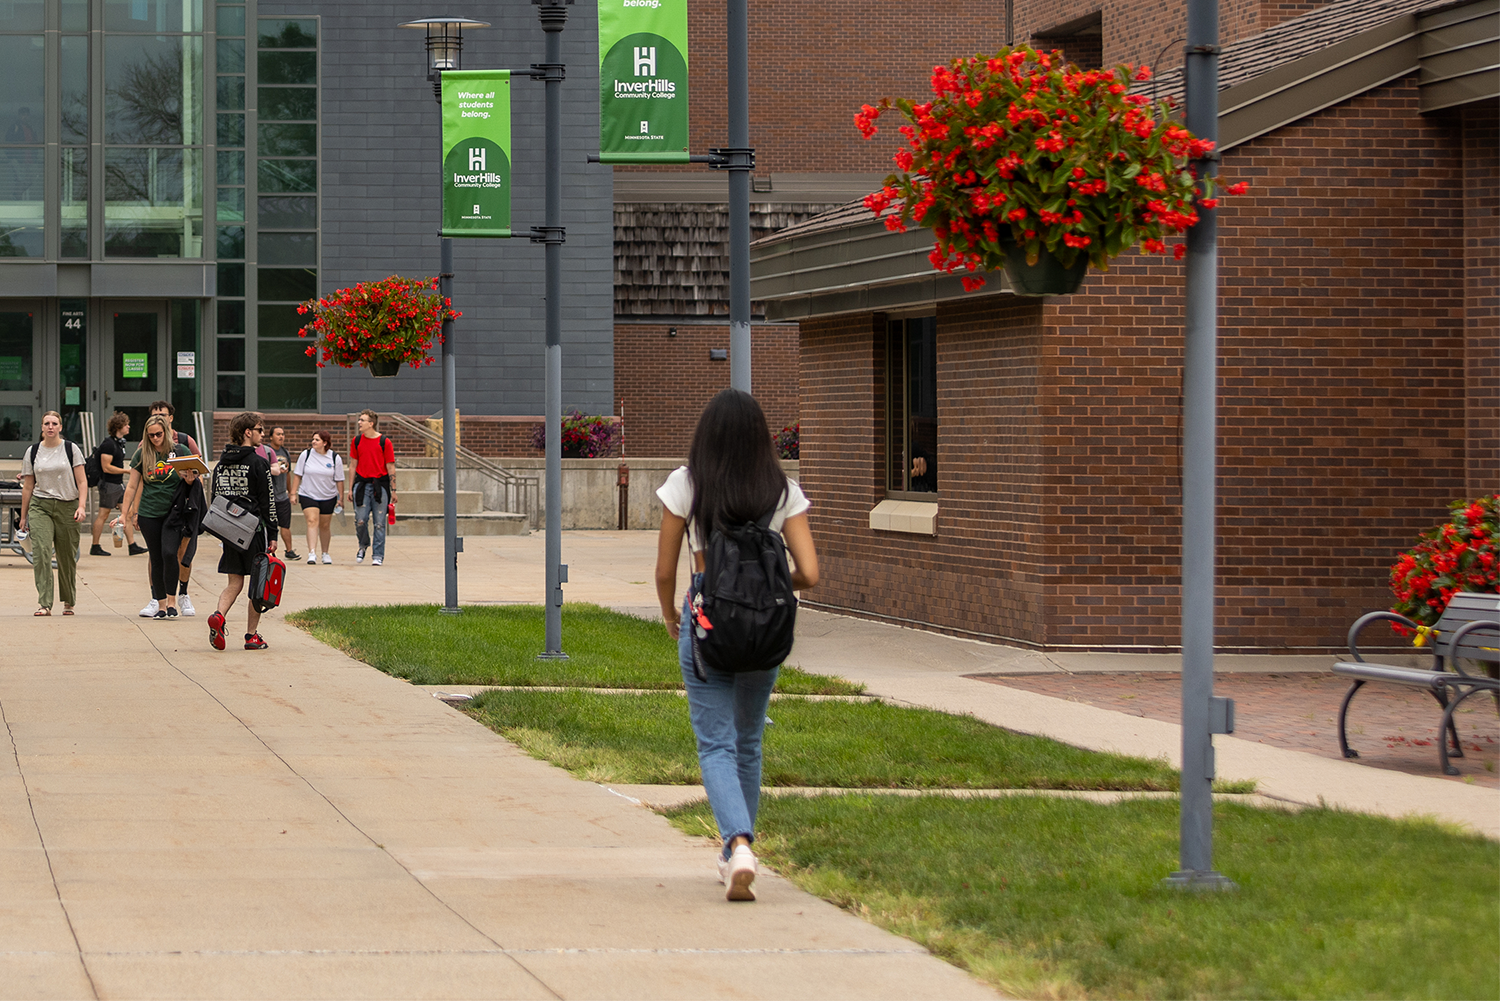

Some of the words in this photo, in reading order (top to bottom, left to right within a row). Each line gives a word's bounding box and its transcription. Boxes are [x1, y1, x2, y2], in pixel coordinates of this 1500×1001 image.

[614, 79, 676, 93] InverHills
[458, 91, 484, 99] Where
[485, 91, 495, 99] all
[614, 92, 651, 100] Community
[461, 110, 491, 119] belong.
[453, 172, 501, 183] InverHills
[64, 318, 82, 330] 44
